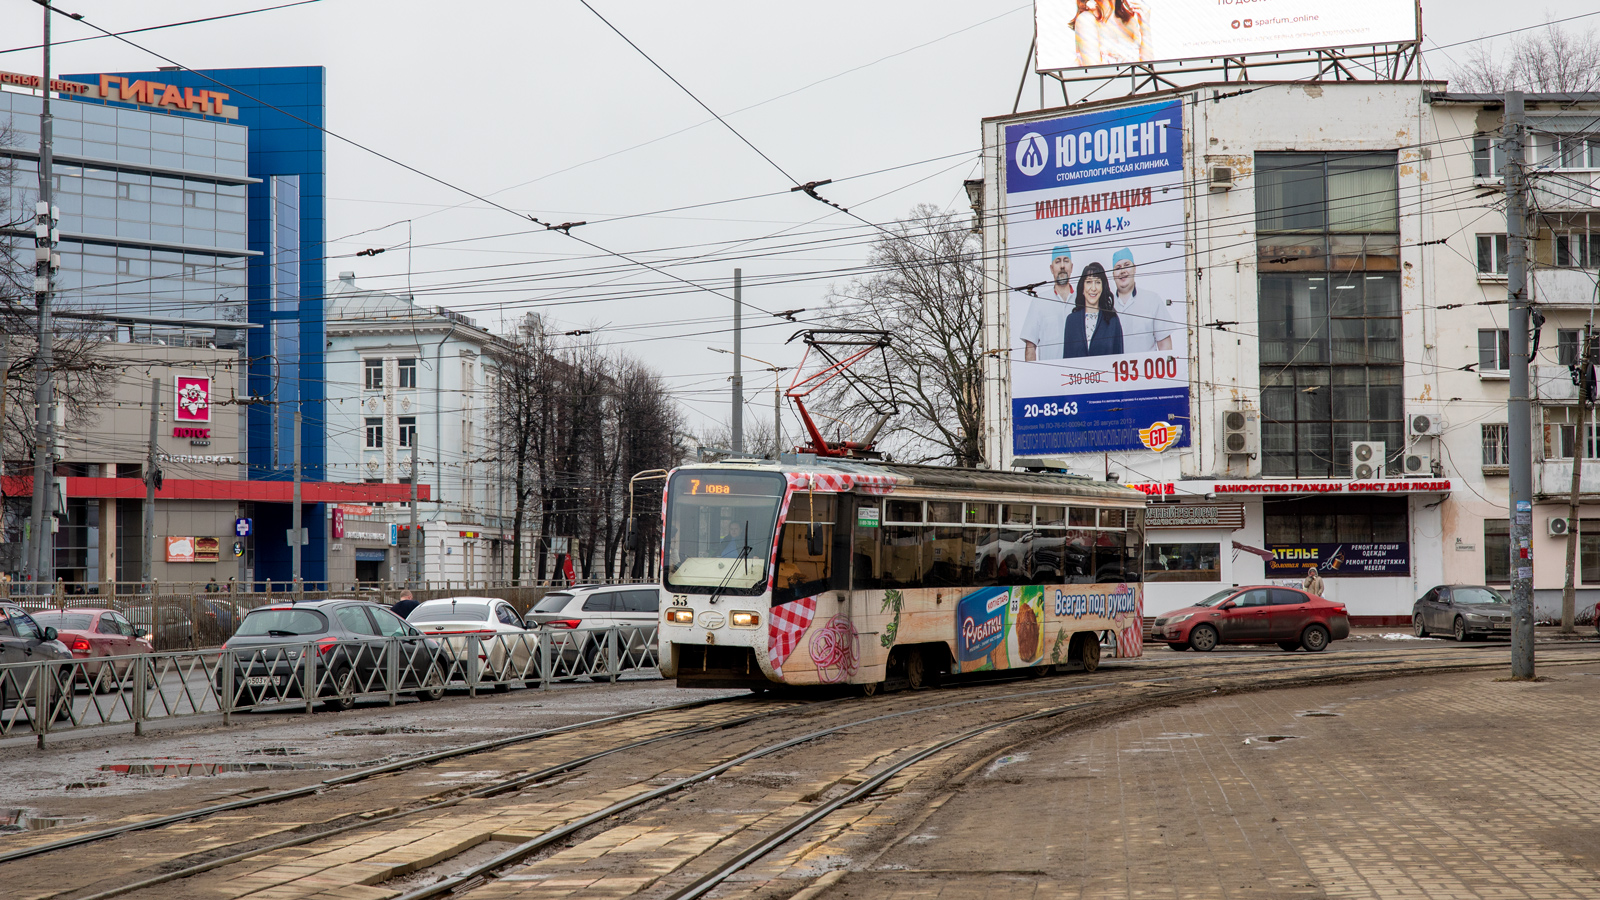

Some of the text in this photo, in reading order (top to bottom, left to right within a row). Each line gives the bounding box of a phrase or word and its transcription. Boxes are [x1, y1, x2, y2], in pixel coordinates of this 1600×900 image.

[1255, 14, 1319, 26] sparfum_online
[99, 73, 230, 114] ГИГАНТ
[1055, 118, 1171, 168] ЮСОДЕНТ
[1056, 158, 1169, 182] СТОМАТОЛОГИЧЕСКАЯ КЛИНИКА
[1035, 186, 1152, 220] ИМПЛАНТАЦИЯ
[1056, 219, 1083, 238] «ВСЁ
[1087, 219, 1101, 235] НА
[1085, 371, 1100, 384] 000
[1112, 359, 1139, 382] 193
[1144, 357, 1177, 380] 000
[1024, 401, 1078, 418] 20-83-63
[1149, 427, 1168, 447] GD
[691, 479, 700, 495] 7
[1214, 480, 1451, 493] БАНКРОТСТВО ГРАЖДАН ЮРИСТ ДЛЯ ЛЮДЕЙ
[1177, 507, 1218, 518] РЕСТОРАН
[1271, 548, 1319, 560] АТЕЛЬЕ
[672, 594, 688, 607] 33
[1055, 587, 1136, 619] Всегда под рукой!
